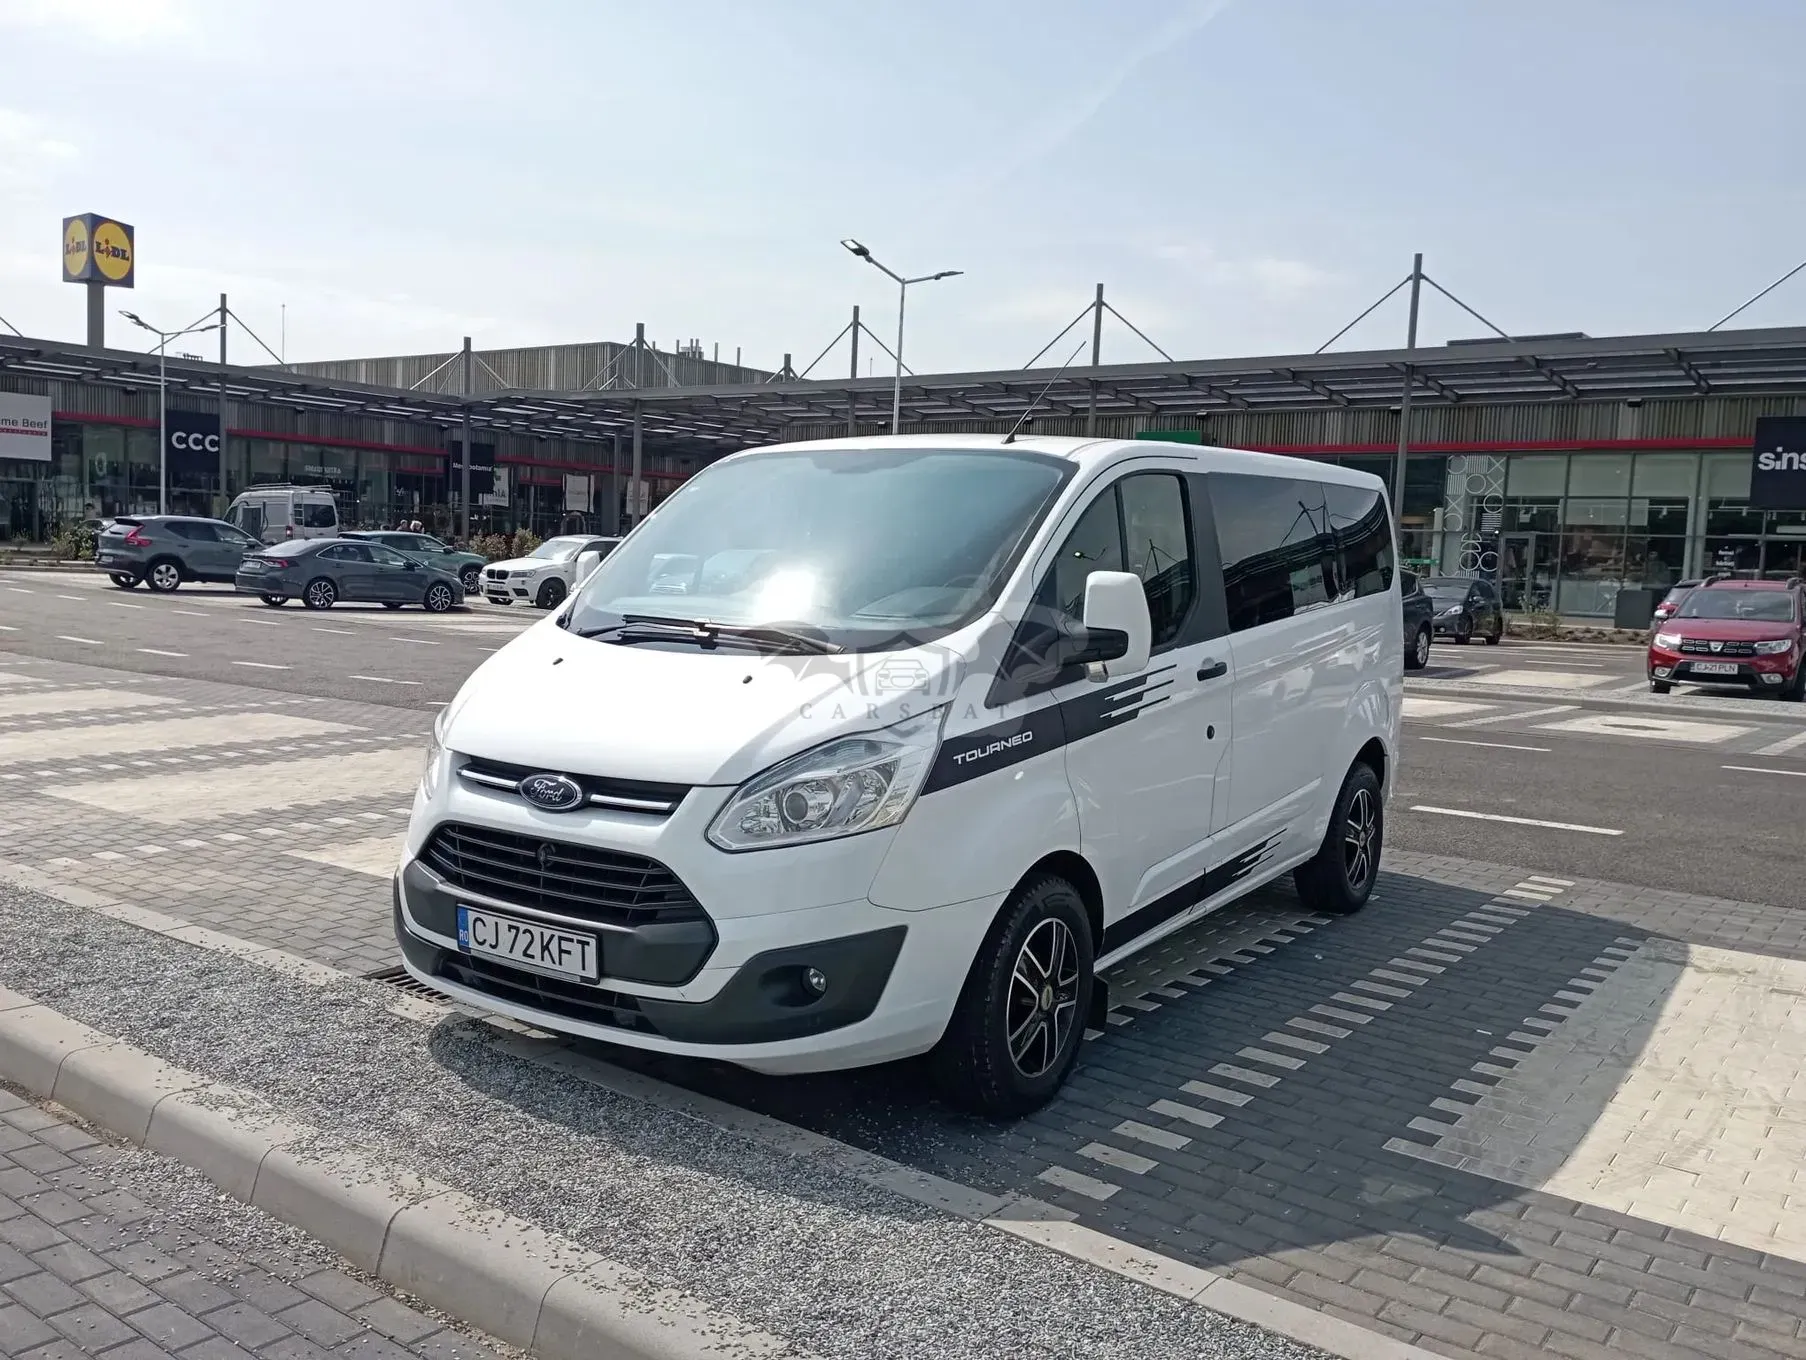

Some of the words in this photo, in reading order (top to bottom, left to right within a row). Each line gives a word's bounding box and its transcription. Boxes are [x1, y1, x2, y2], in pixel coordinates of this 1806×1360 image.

[22, 418, 48, 429] Beef
[171, 431, 220, 453] CCC
[952, 730, 1034, 766] TOURNEO
[530, 778, 566, 803] Ford
[459, 928, 470, 943] RO
